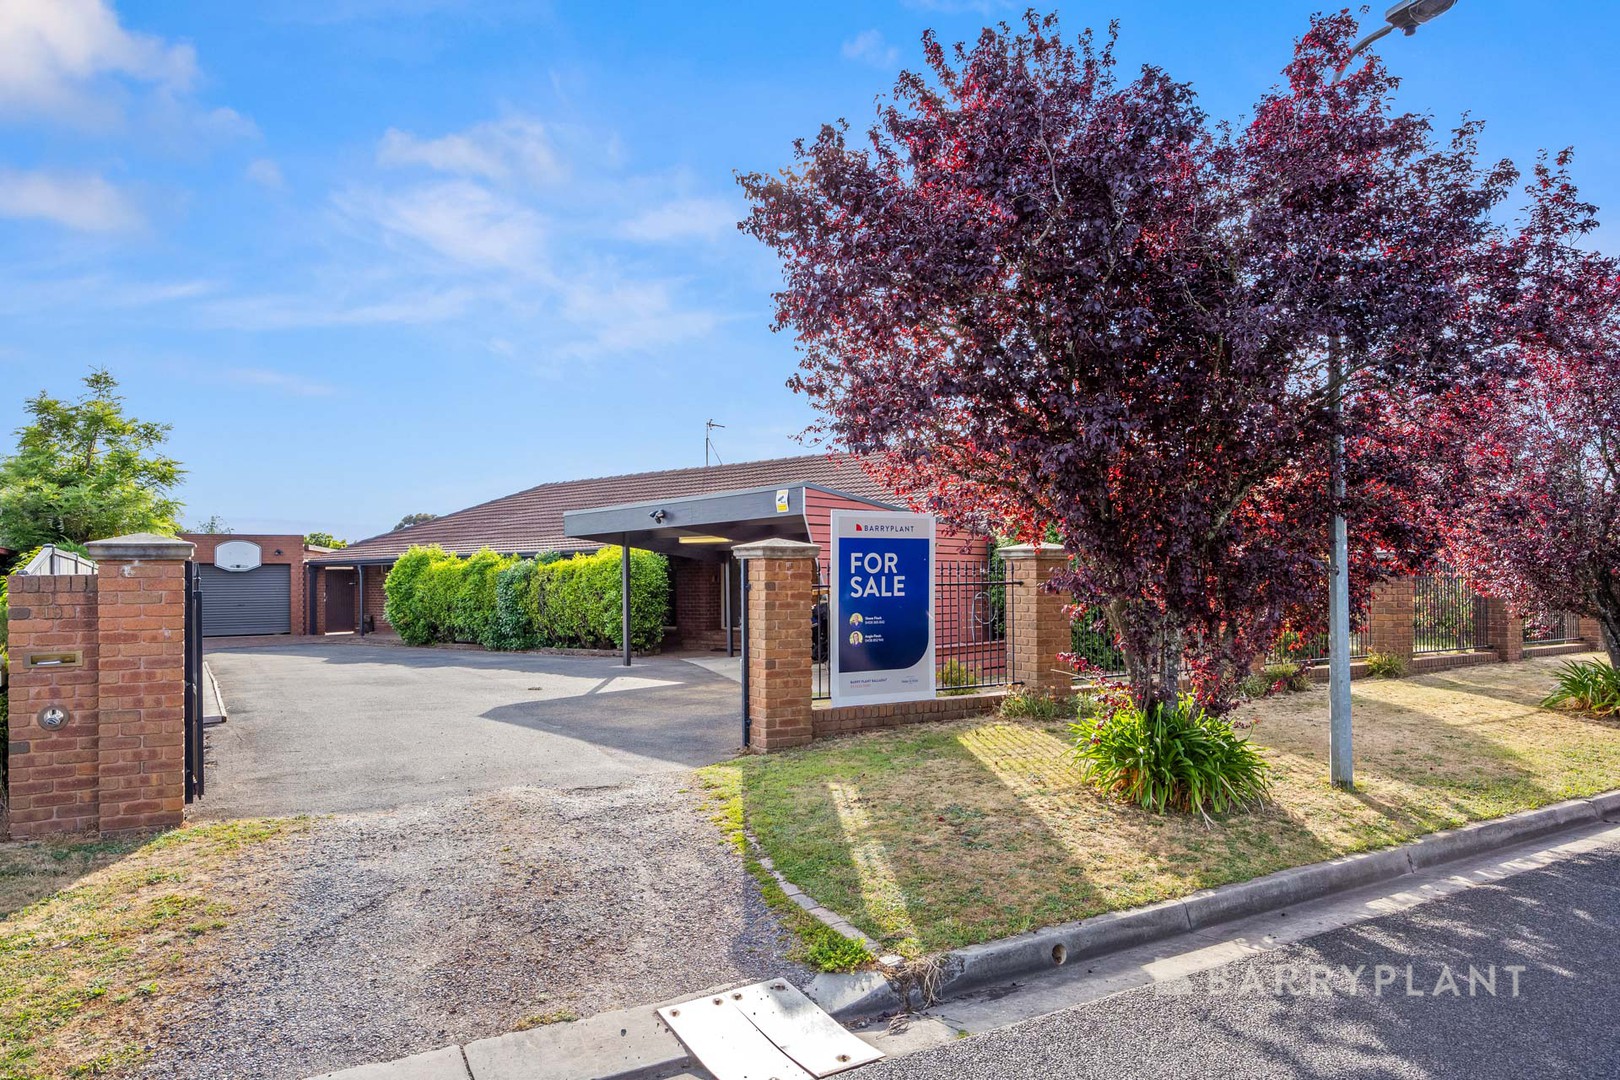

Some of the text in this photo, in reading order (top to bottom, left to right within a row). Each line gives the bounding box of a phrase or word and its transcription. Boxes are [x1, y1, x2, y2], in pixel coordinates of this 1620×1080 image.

[864, 525, 915, 533] BARRYPLANT
[850, 552, 898, 574] FOR
[850, 575, 906, 598] SALE
